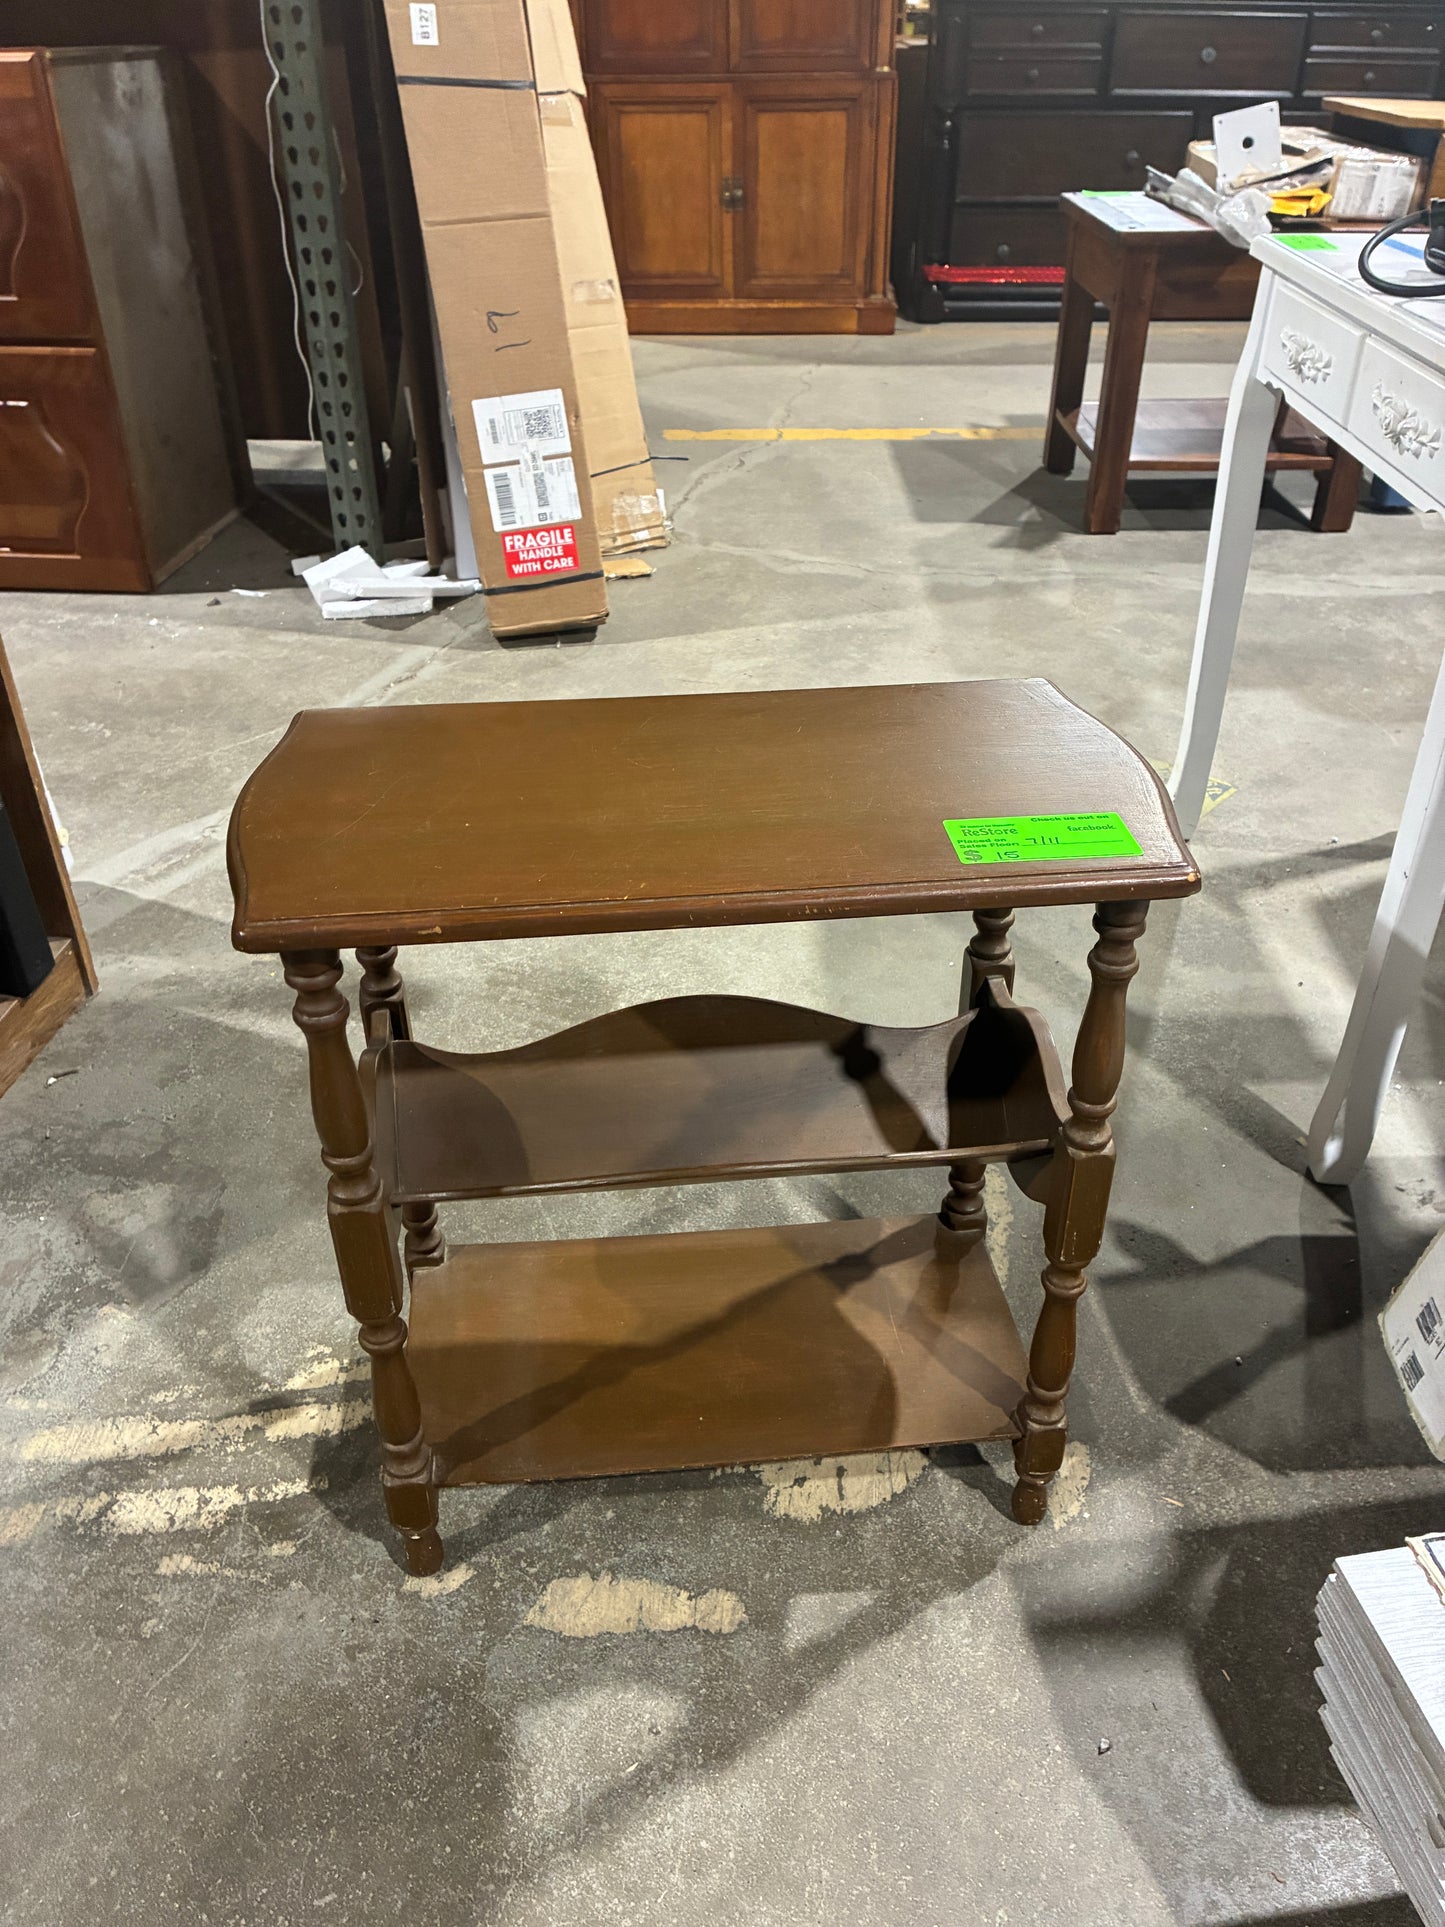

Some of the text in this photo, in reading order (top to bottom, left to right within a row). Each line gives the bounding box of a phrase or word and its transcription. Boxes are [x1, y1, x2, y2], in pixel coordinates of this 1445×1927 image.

[504, 528, 574, 550] FRAGILE
[518, 545, 564, 561] HANDLE
[511, 556, 574, 575] WITH CARE
[961, 827, 1019, 837] ReStore
[963, 849, 1020, 862] $ 15
